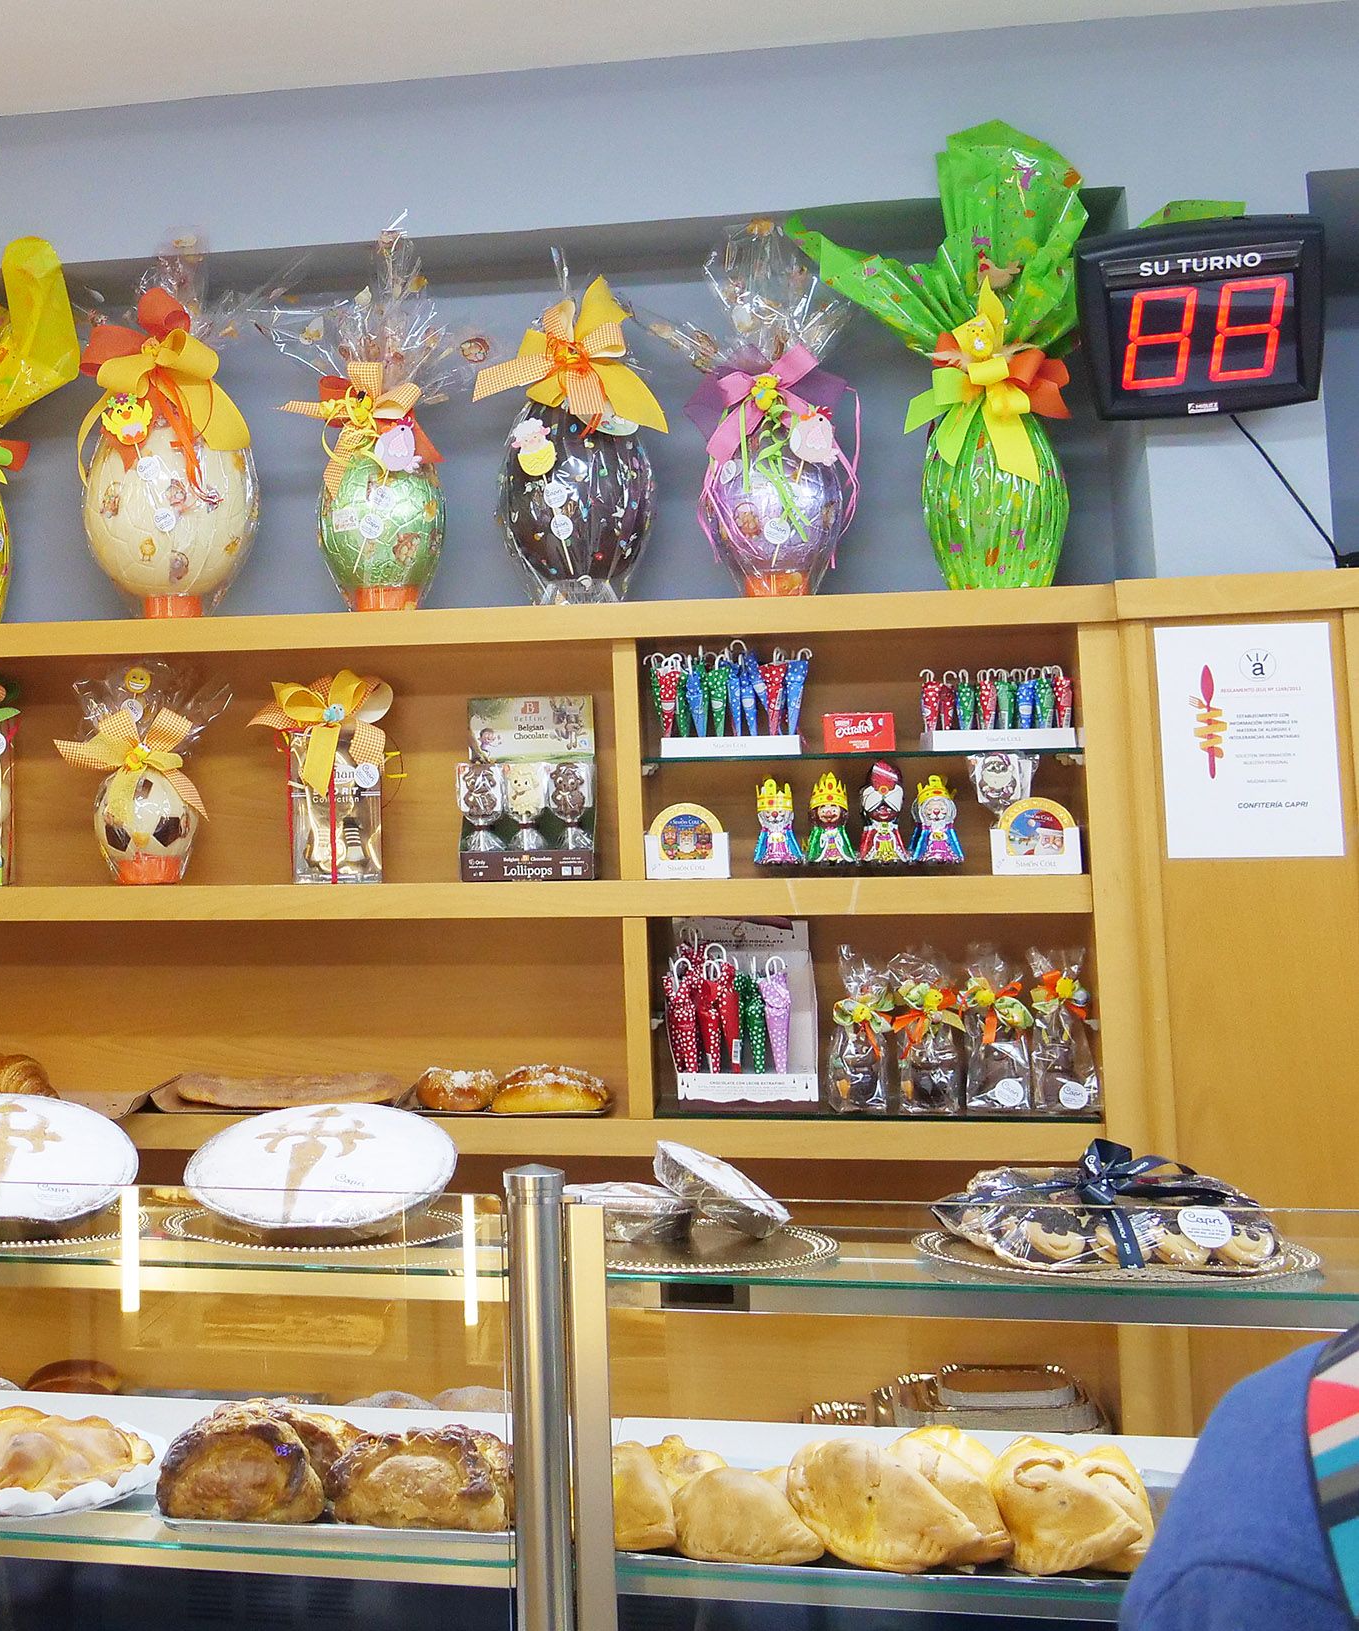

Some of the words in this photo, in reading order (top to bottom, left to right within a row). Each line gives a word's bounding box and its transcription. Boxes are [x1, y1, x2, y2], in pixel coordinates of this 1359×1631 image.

[1139, 260, 1170, 277] SU
[1177, 252, 1262, 274] TURNO
[1122, 276, 1288, 391] 88
[518, 724, 545, 732] Belgian
[514, 732, 549, 740] Chocolate
[1237, 801, 1283, 809] CONFITERÍA
[503, 865, 553, 878] Lollipops
[1183, 1211, 1223, 1225] Capri
